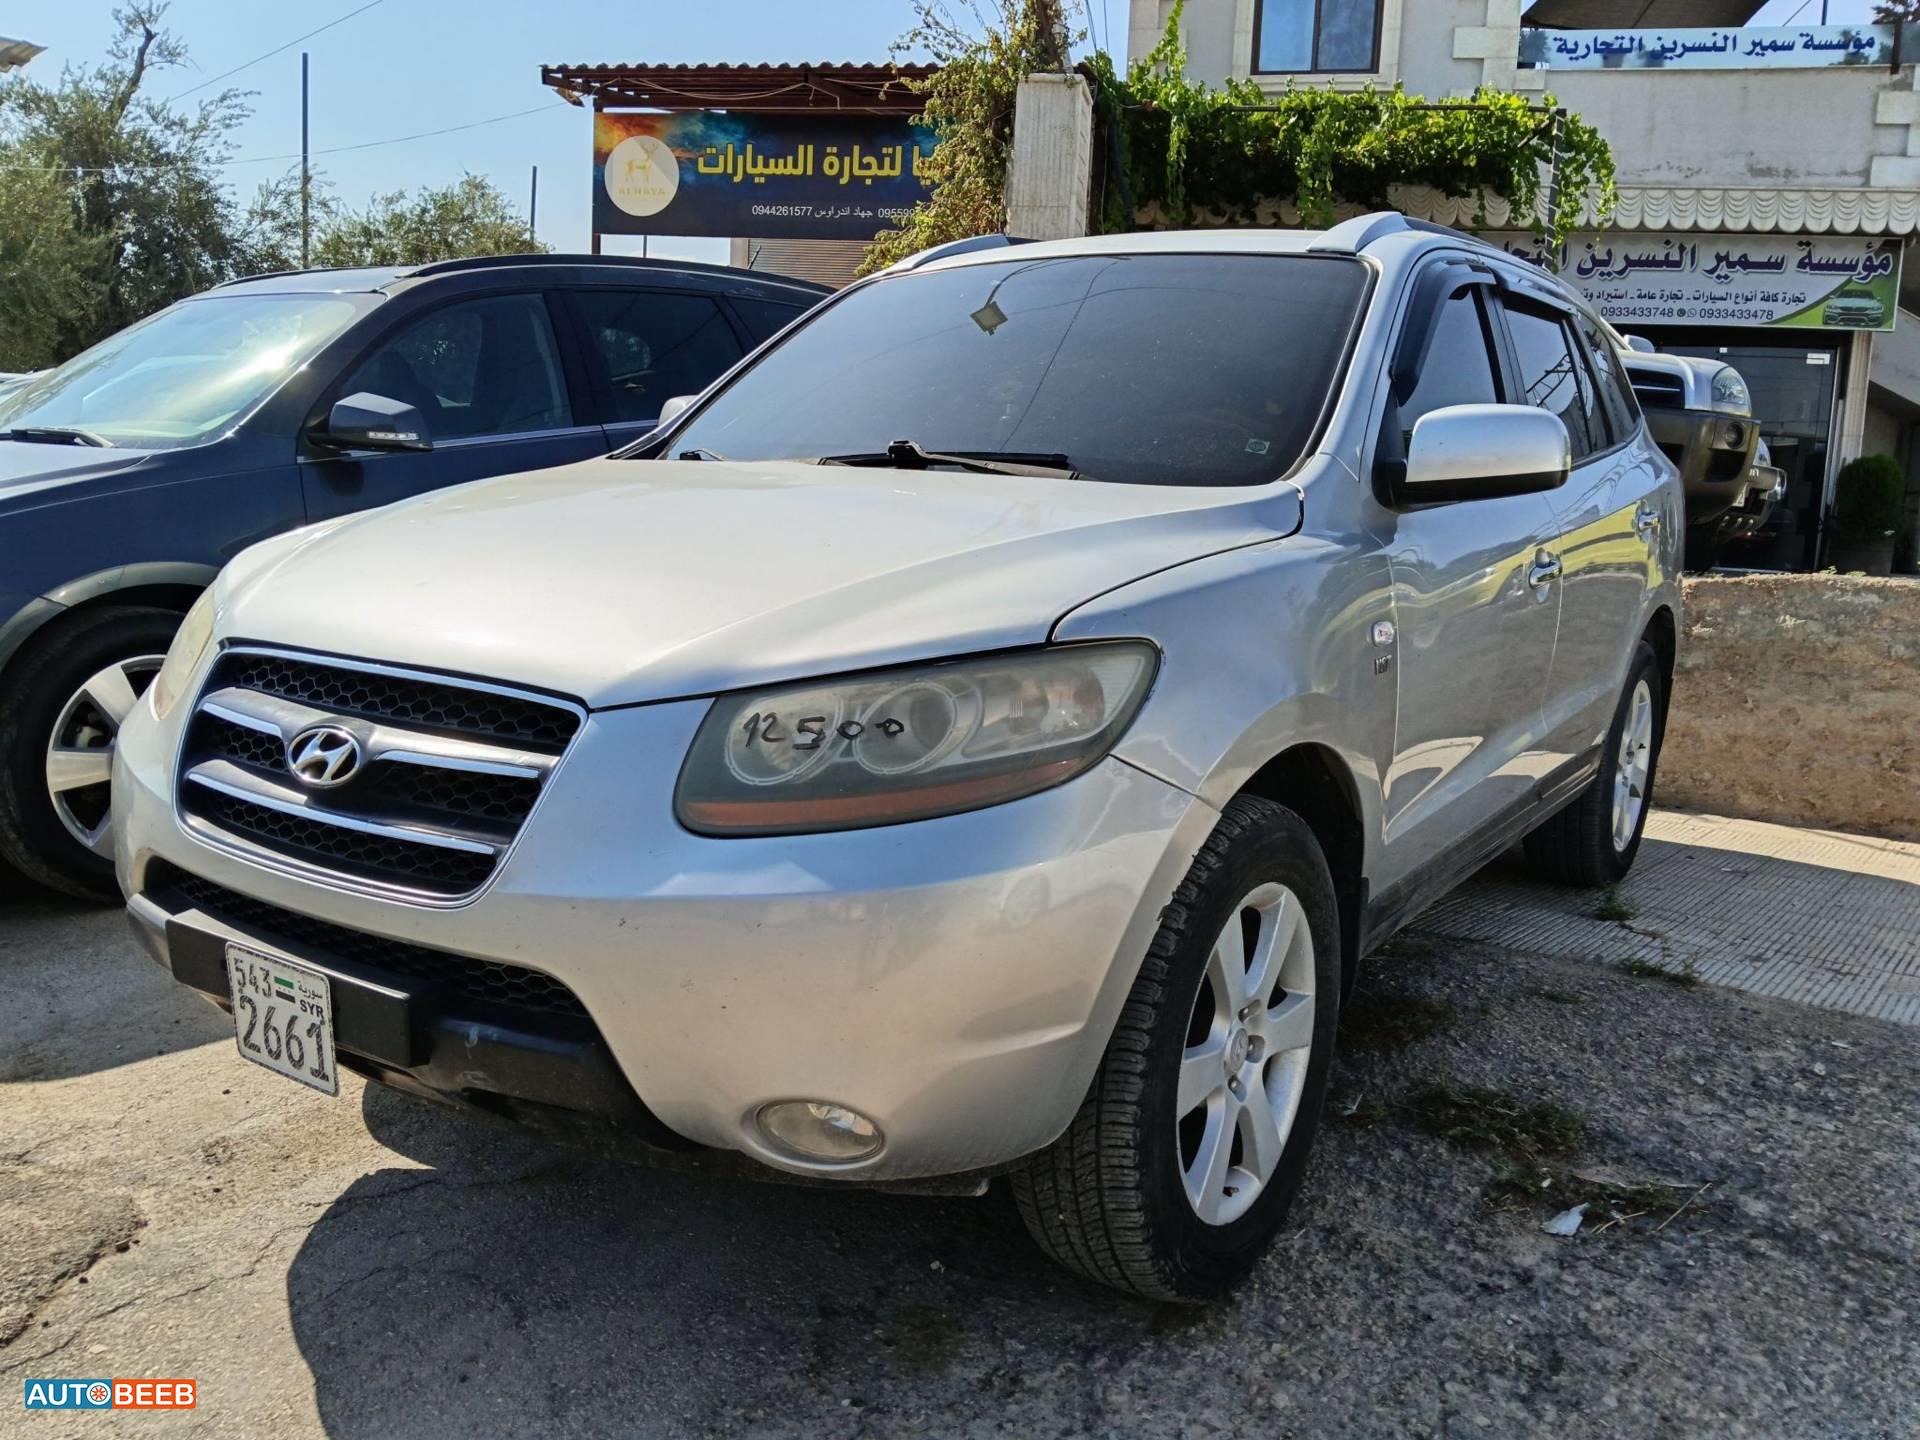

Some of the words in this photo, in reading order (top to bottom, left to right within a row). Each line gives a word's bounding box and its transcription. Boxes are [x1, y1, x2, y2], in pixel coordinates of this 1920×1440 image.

[1553, 34, 1643, 61] التجارية
[1650, 32, 1736, 60] النسرين
[1743, 38, 1796, 56] سمير
[1800, 31, 1875, 55] مؤسسة
[697, 143, 813, 183] السيارات
[823, 145, 902, 185] لتجارة
[752, 204, 812, 217] 0944261577
[853, 206, 873, 218] جهاد
[1576, 238, 1697, 278] النسرين
[1703, 249, 1786, 282] سمير
[1797, 240, 1892, 282] مؤسسة
[1596, 288, 1628, 303] استيراد
[1636, 288, 1657, 300] عامة
[1659, 289, 1684, 304] تجارة
[1692, 290, 1732, 305] السيارات
[1735, 289, 1758, 305] أنواع
[1759, 291, 1780, 303] كافة
[1782, 291, 1806, 306] تجارة
[1600, 306, 1674, 318] 0933433748
[1699, 307, 1774, 320] 0933433478
[743, 712, 905, 750] 12500
[300, 999, 325, 1019] SYR
[240, 994, 330, 1082] 2661
